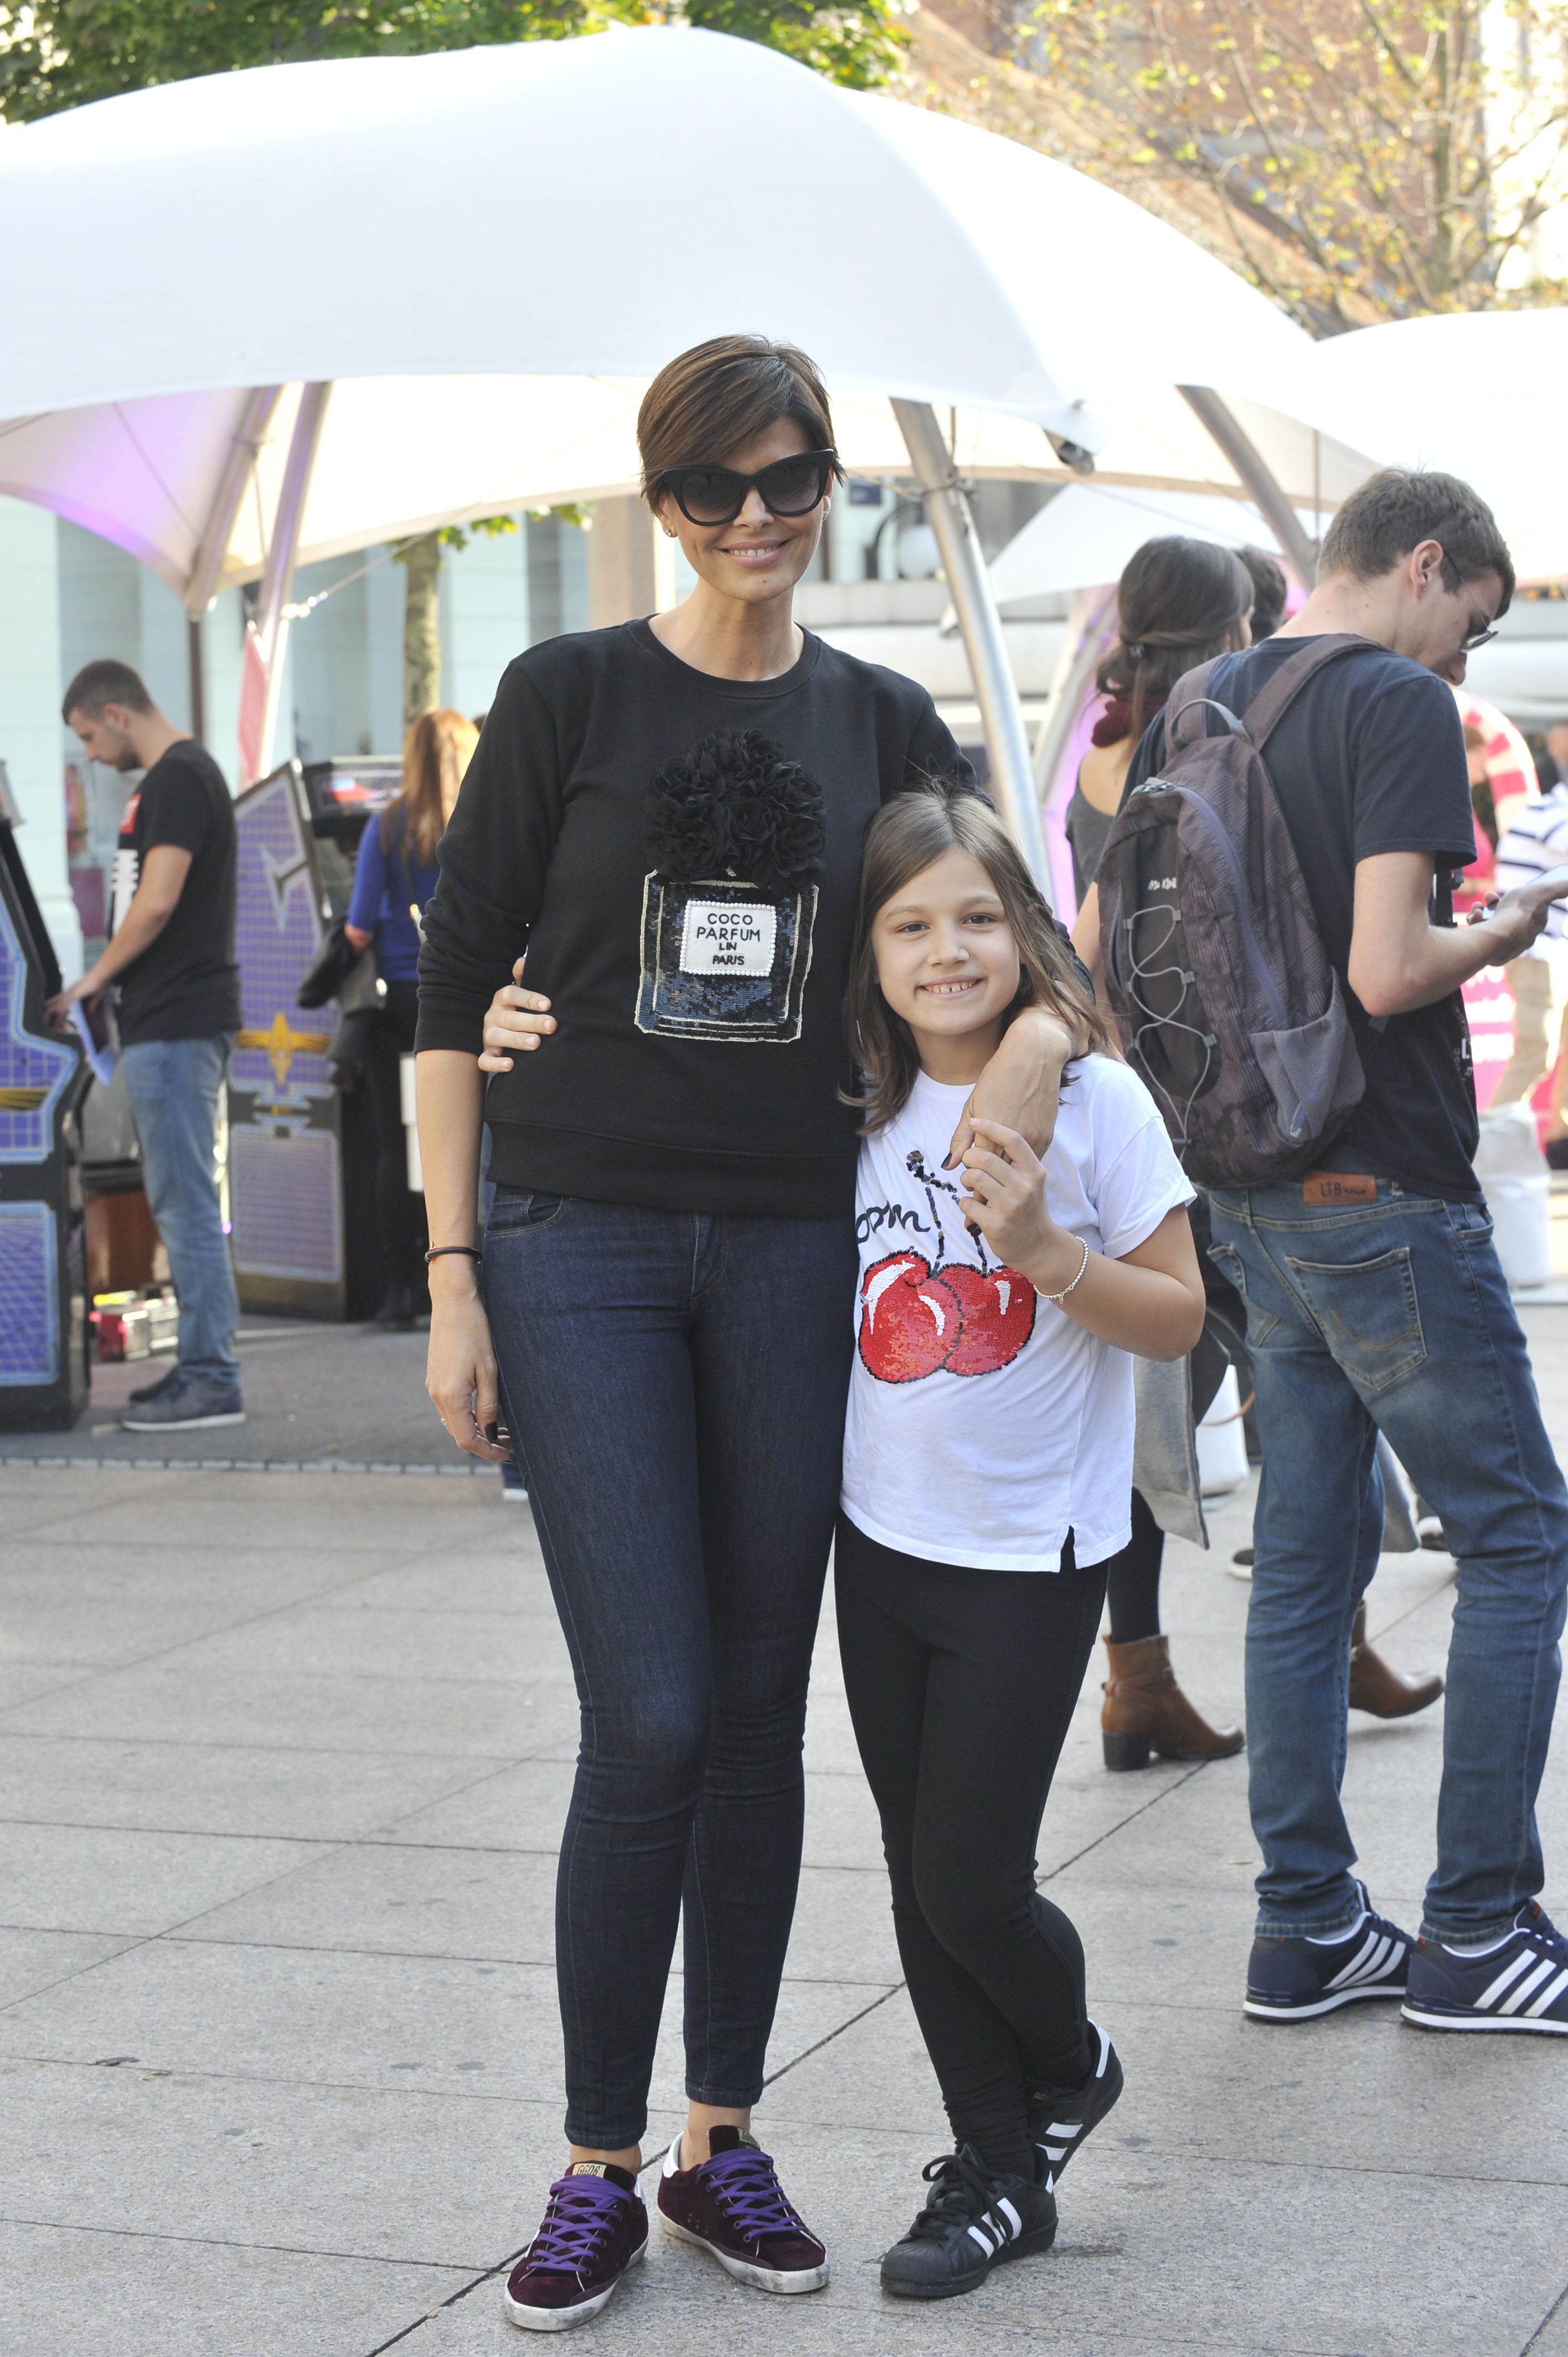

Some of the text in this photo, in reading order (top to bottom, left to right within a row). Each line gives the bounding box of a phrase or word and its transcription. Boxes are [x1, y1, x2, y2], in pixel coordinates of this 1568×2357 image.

[707, 913, 753, 925] COCO
[697, 927, 760, 941] PARFUM
[719, 943, 737, 951] LIN
[712, 955, 745, 965] PARIS
[1320, 1182, 1343, 1197] LTB
[576, 2164, 601, 2176] GGDB
